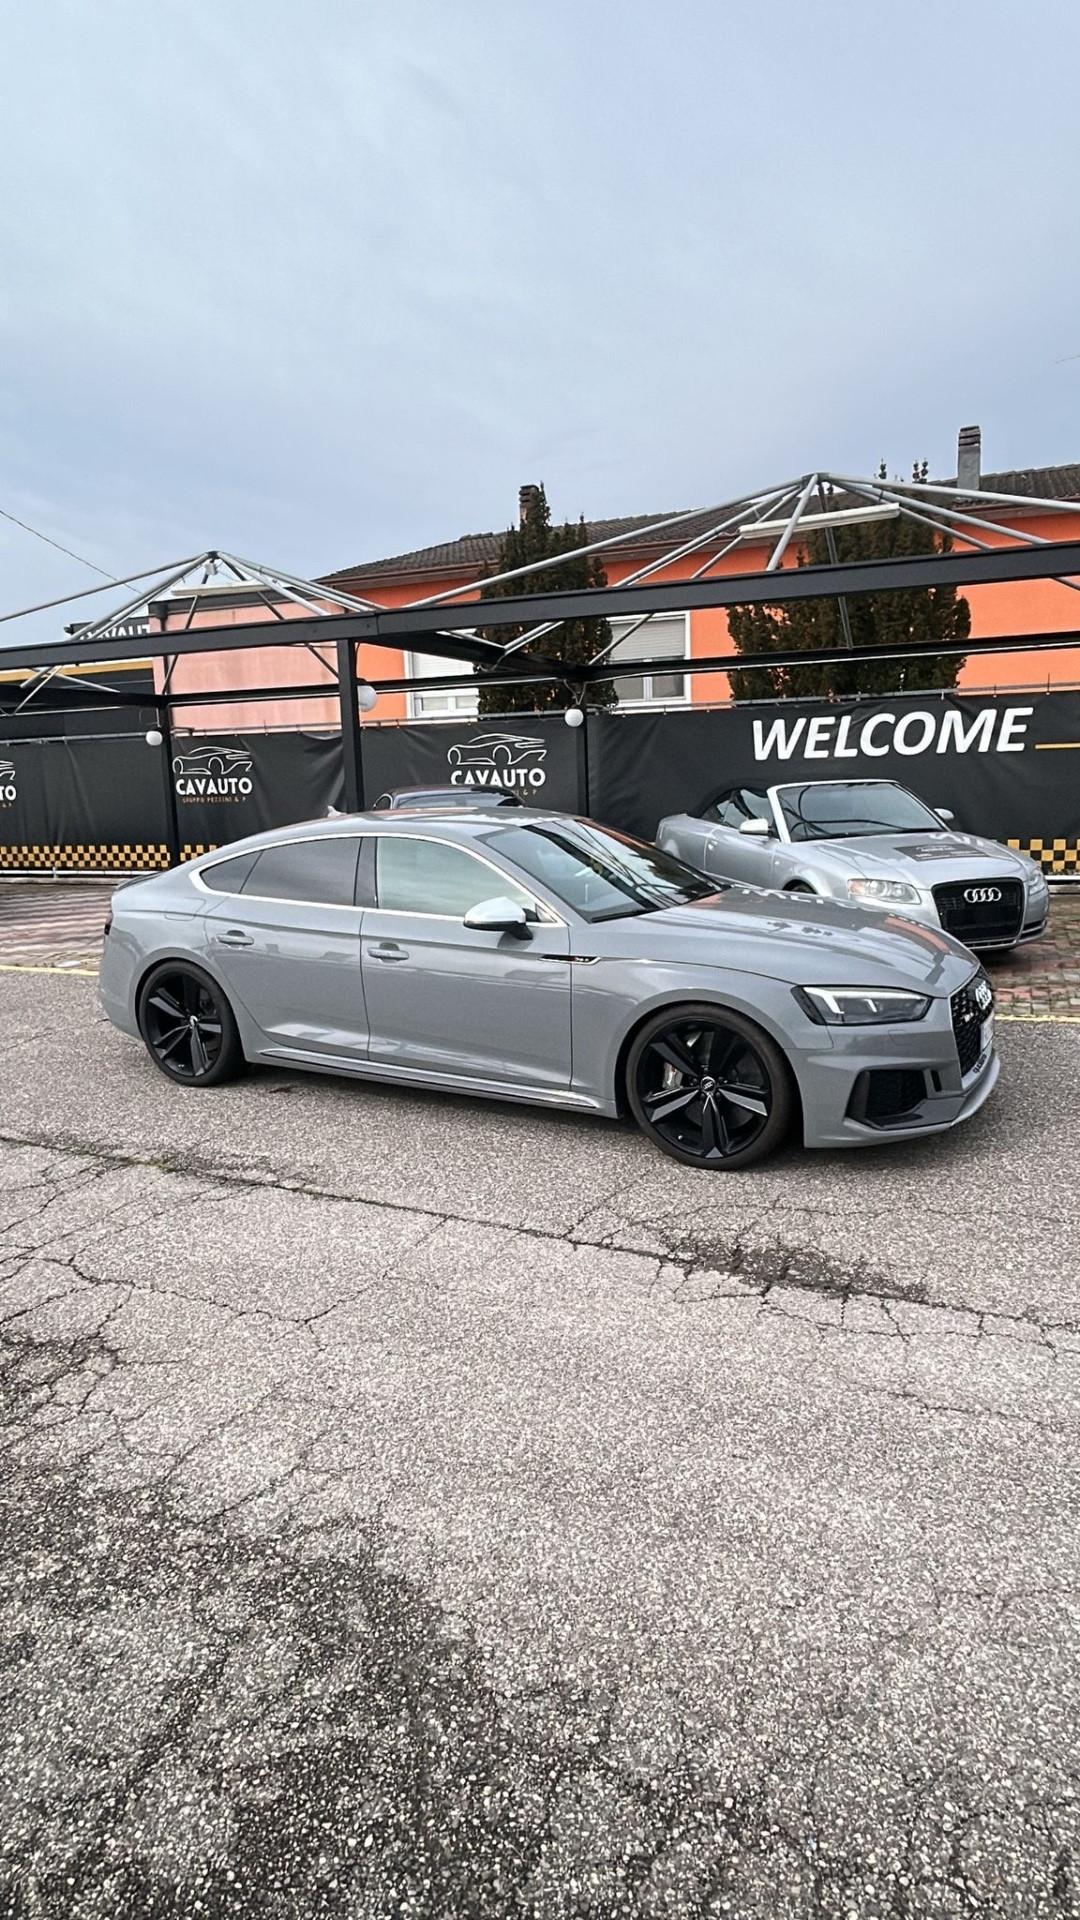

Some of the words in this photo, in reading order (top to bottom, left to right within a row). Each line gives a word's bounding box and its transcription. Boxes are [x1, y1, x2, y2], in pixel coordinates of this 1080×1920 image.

[752, 707, 1034, 761] WELCOME
[175, 777, 253, 795] CAVAUTO
[450, 768, 546, 787] CAVAUTO
